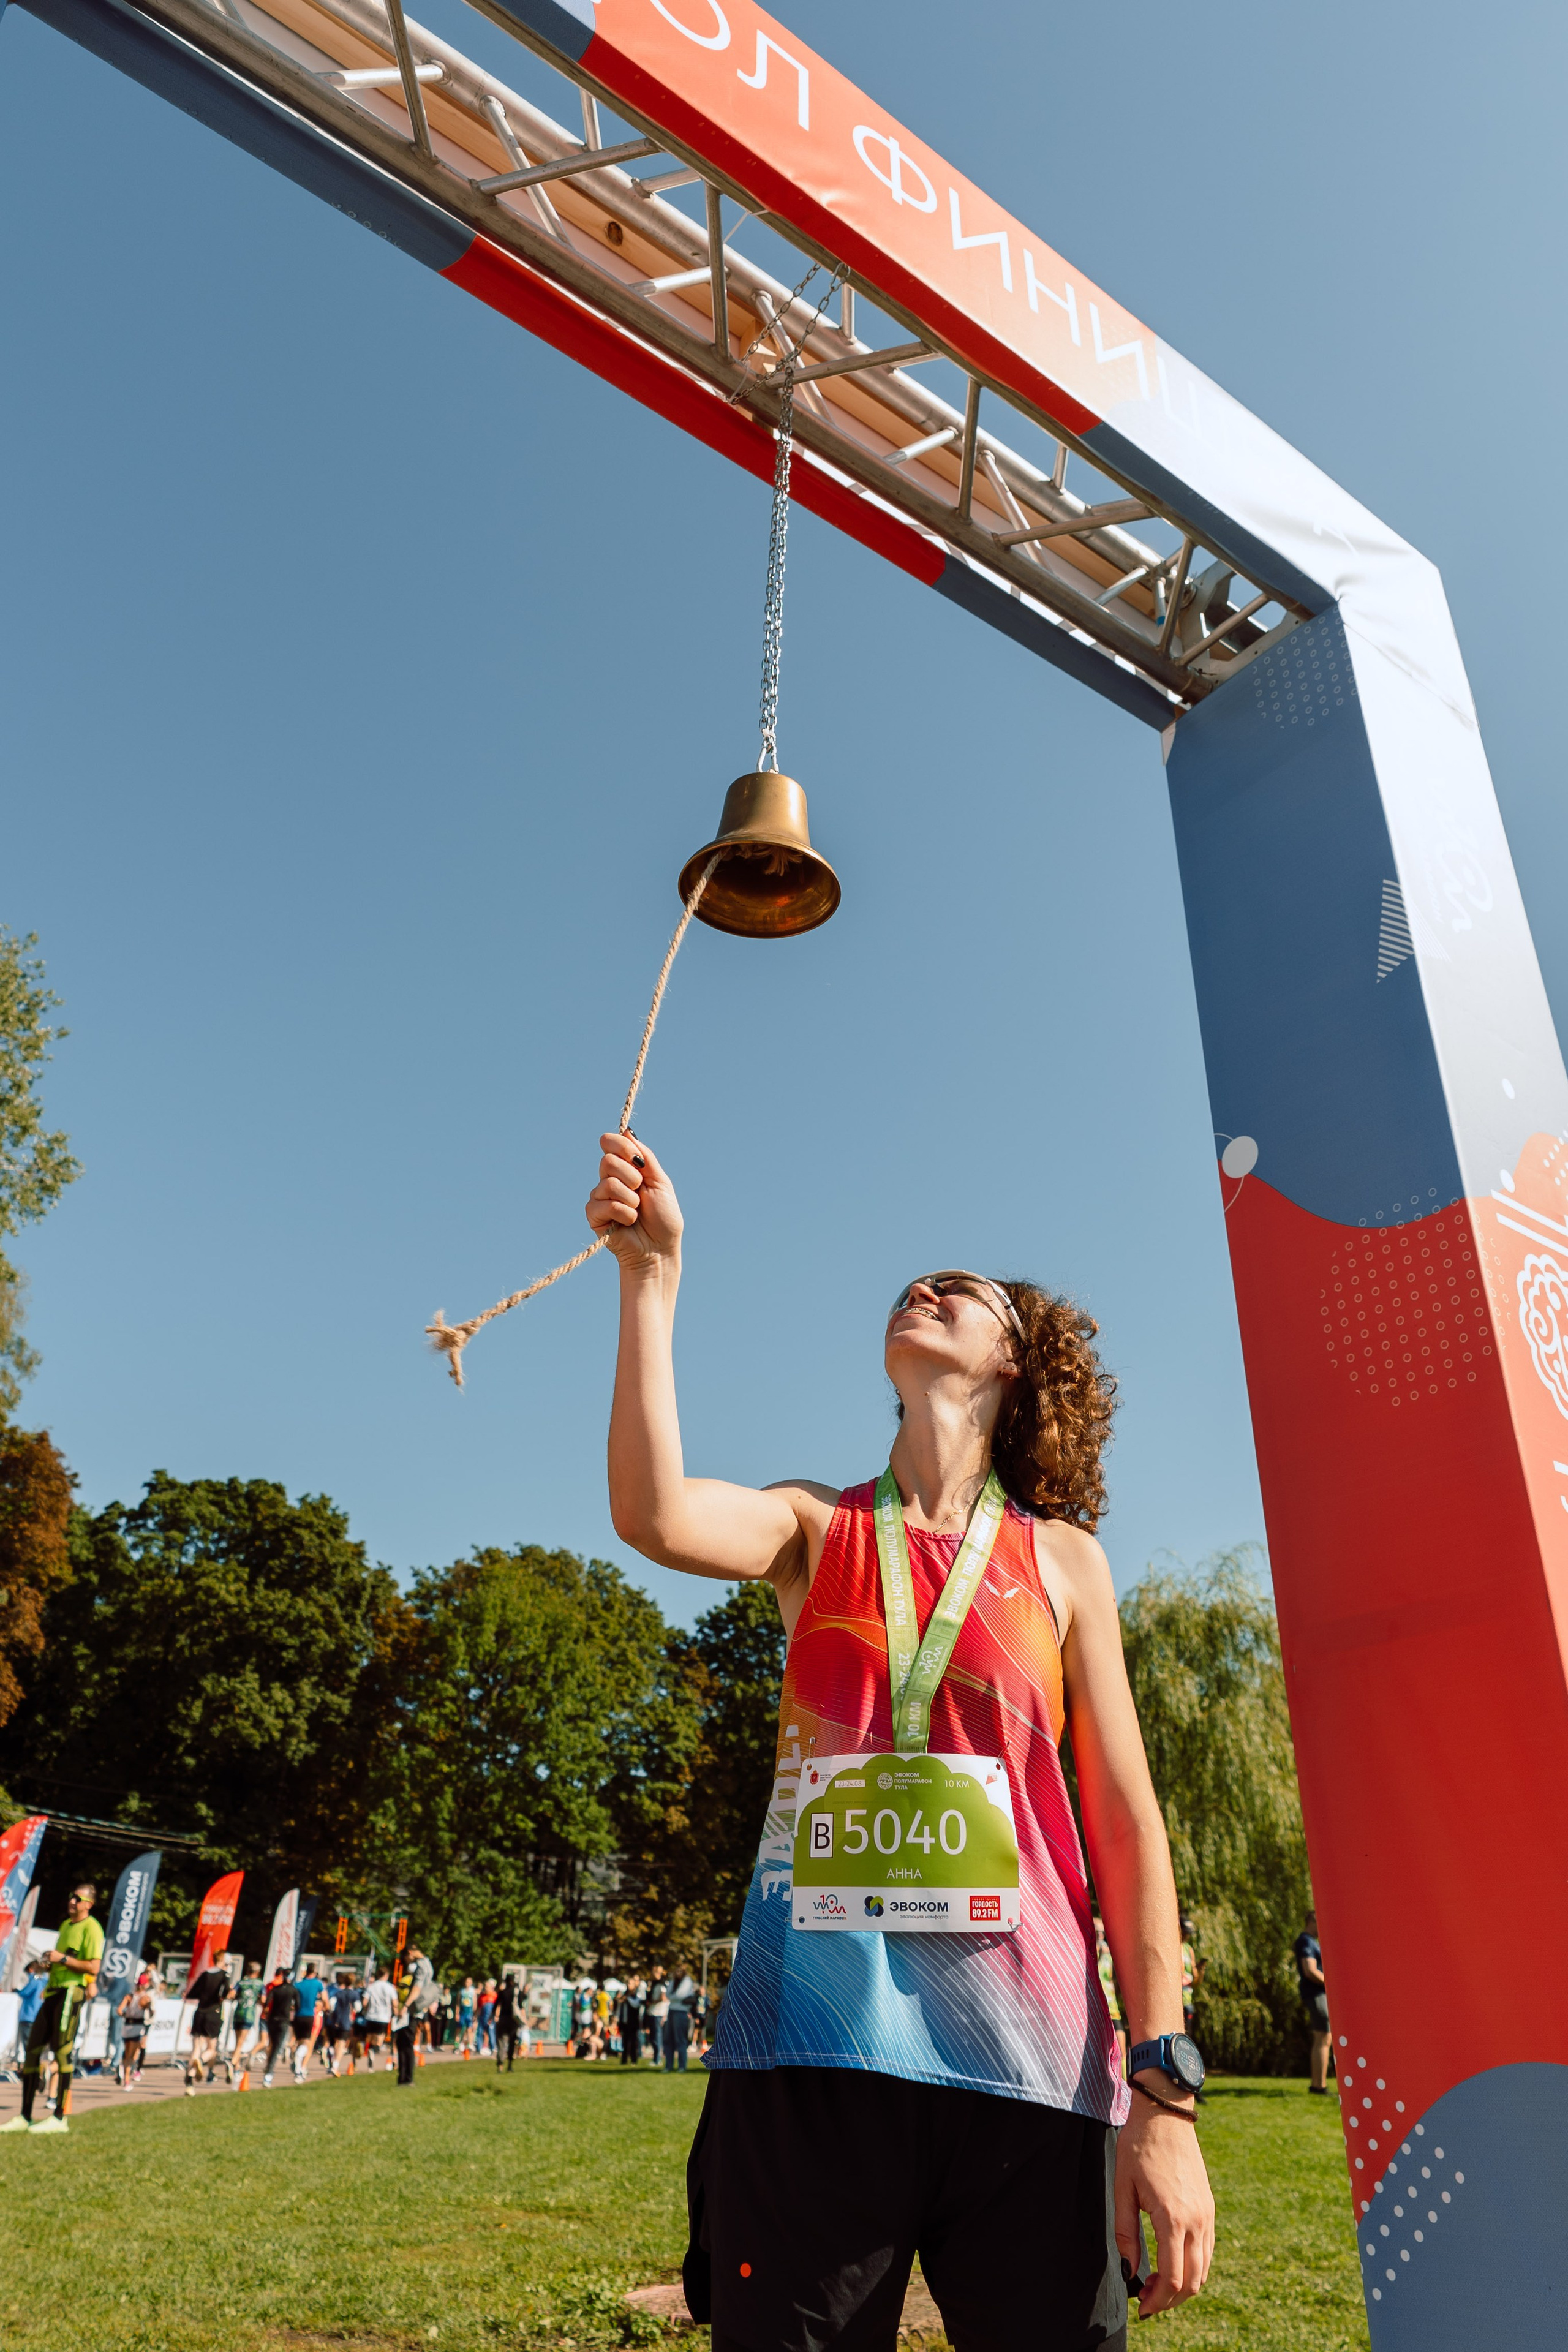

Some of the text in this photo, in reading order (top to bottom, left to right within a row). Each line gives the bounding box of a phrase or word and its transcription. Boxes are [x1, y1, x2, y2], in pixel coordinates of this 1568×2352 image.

[881, 1494, 907, 1626] ЭВОКОМ ПОЛУМАРАФОН ТУЛА
[944, 1577, 969, 1619] ЭВОКОМ
[907, 1722, 919, 1737] 10
[945, 1779, 954, 1788] 10
[843, 1809, 967, 1855] 5040
[887, 1868, 922, 1879] АННА
[116, 1870, 143, 1945] ЭВОКОМ
[889, 1902, 949, 1912] ЭВОКОМ
[972, 1909, 998, 1918] 89.2 FM
